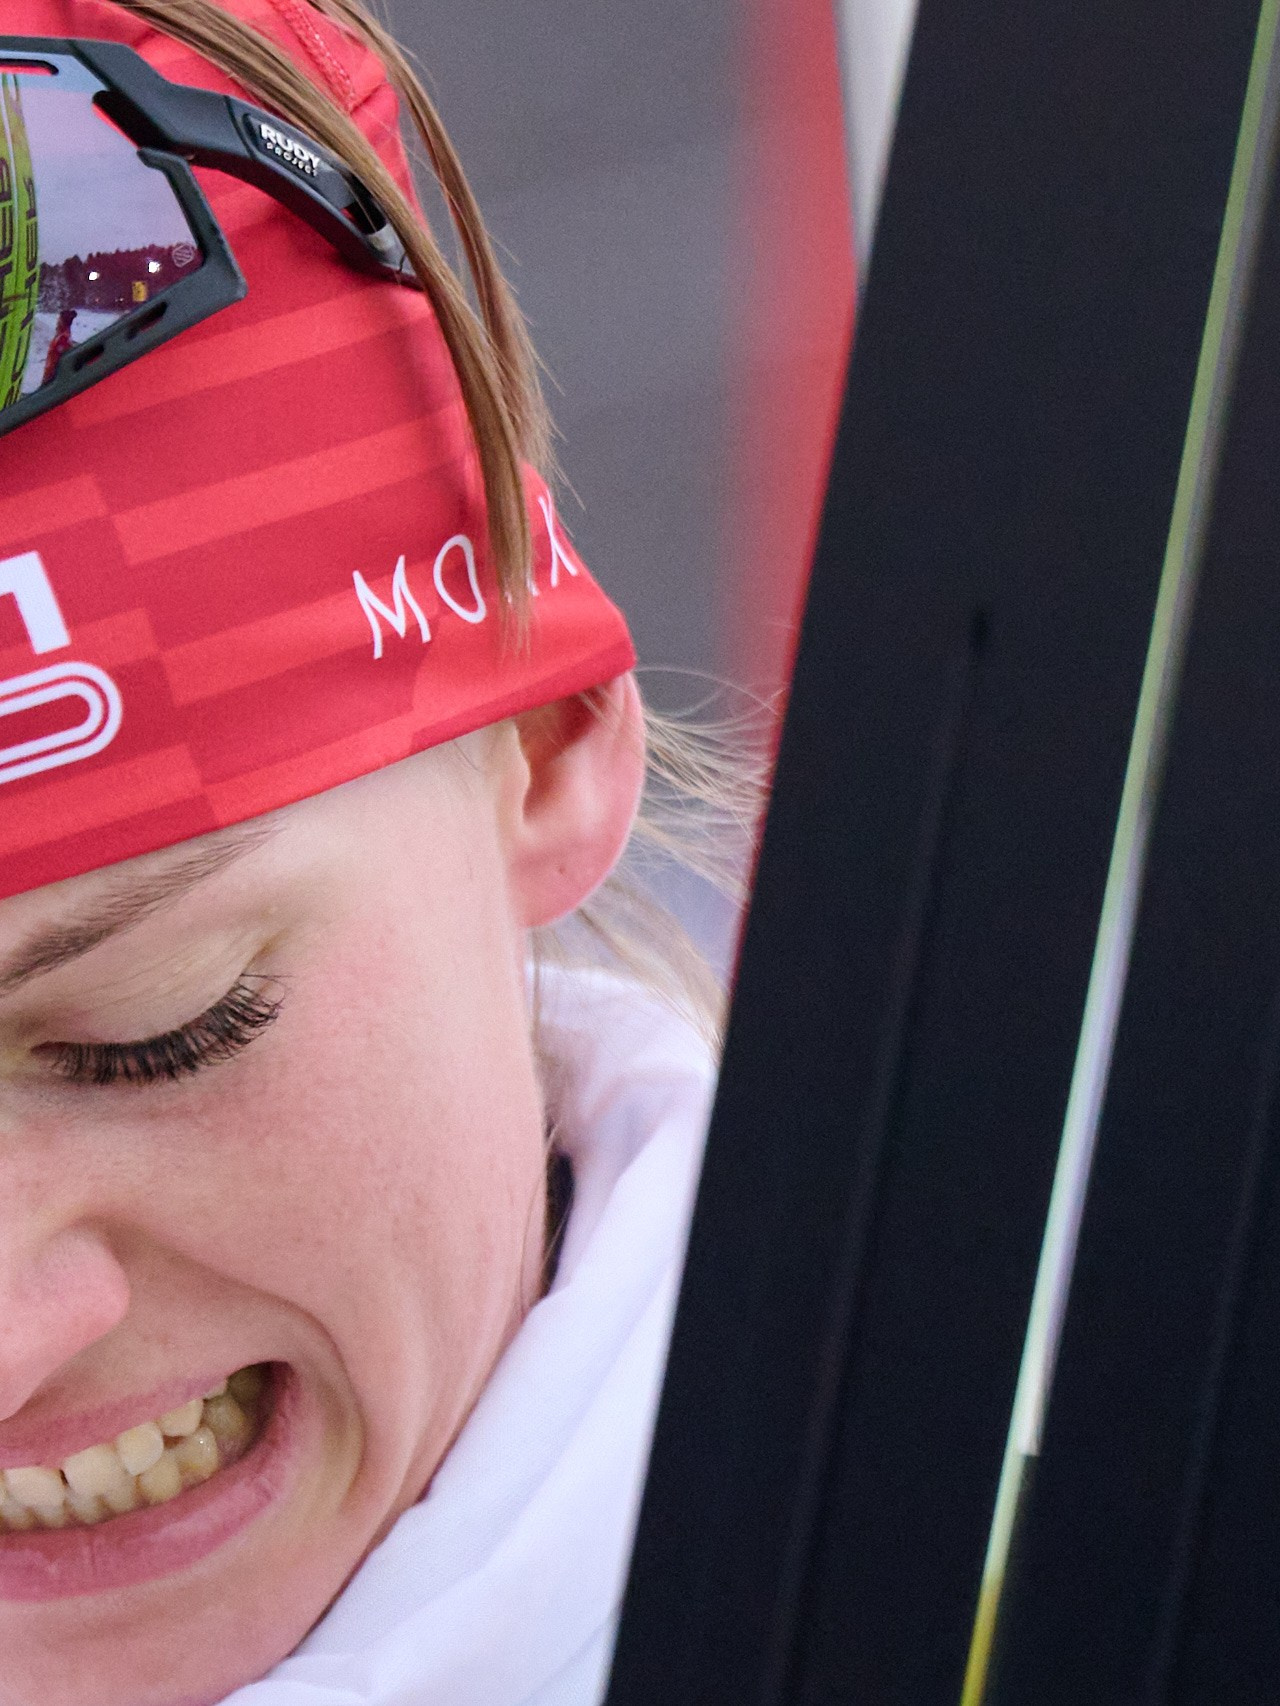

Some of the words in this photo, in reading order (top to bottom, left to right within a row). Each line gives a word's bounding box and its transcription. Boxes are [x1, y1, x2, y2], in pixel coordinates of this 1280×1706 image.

[261, 123, 320, 168] RUDY
[266, 141, 318, 177] PROJECT
[352, 489, 577, 659] MOX
